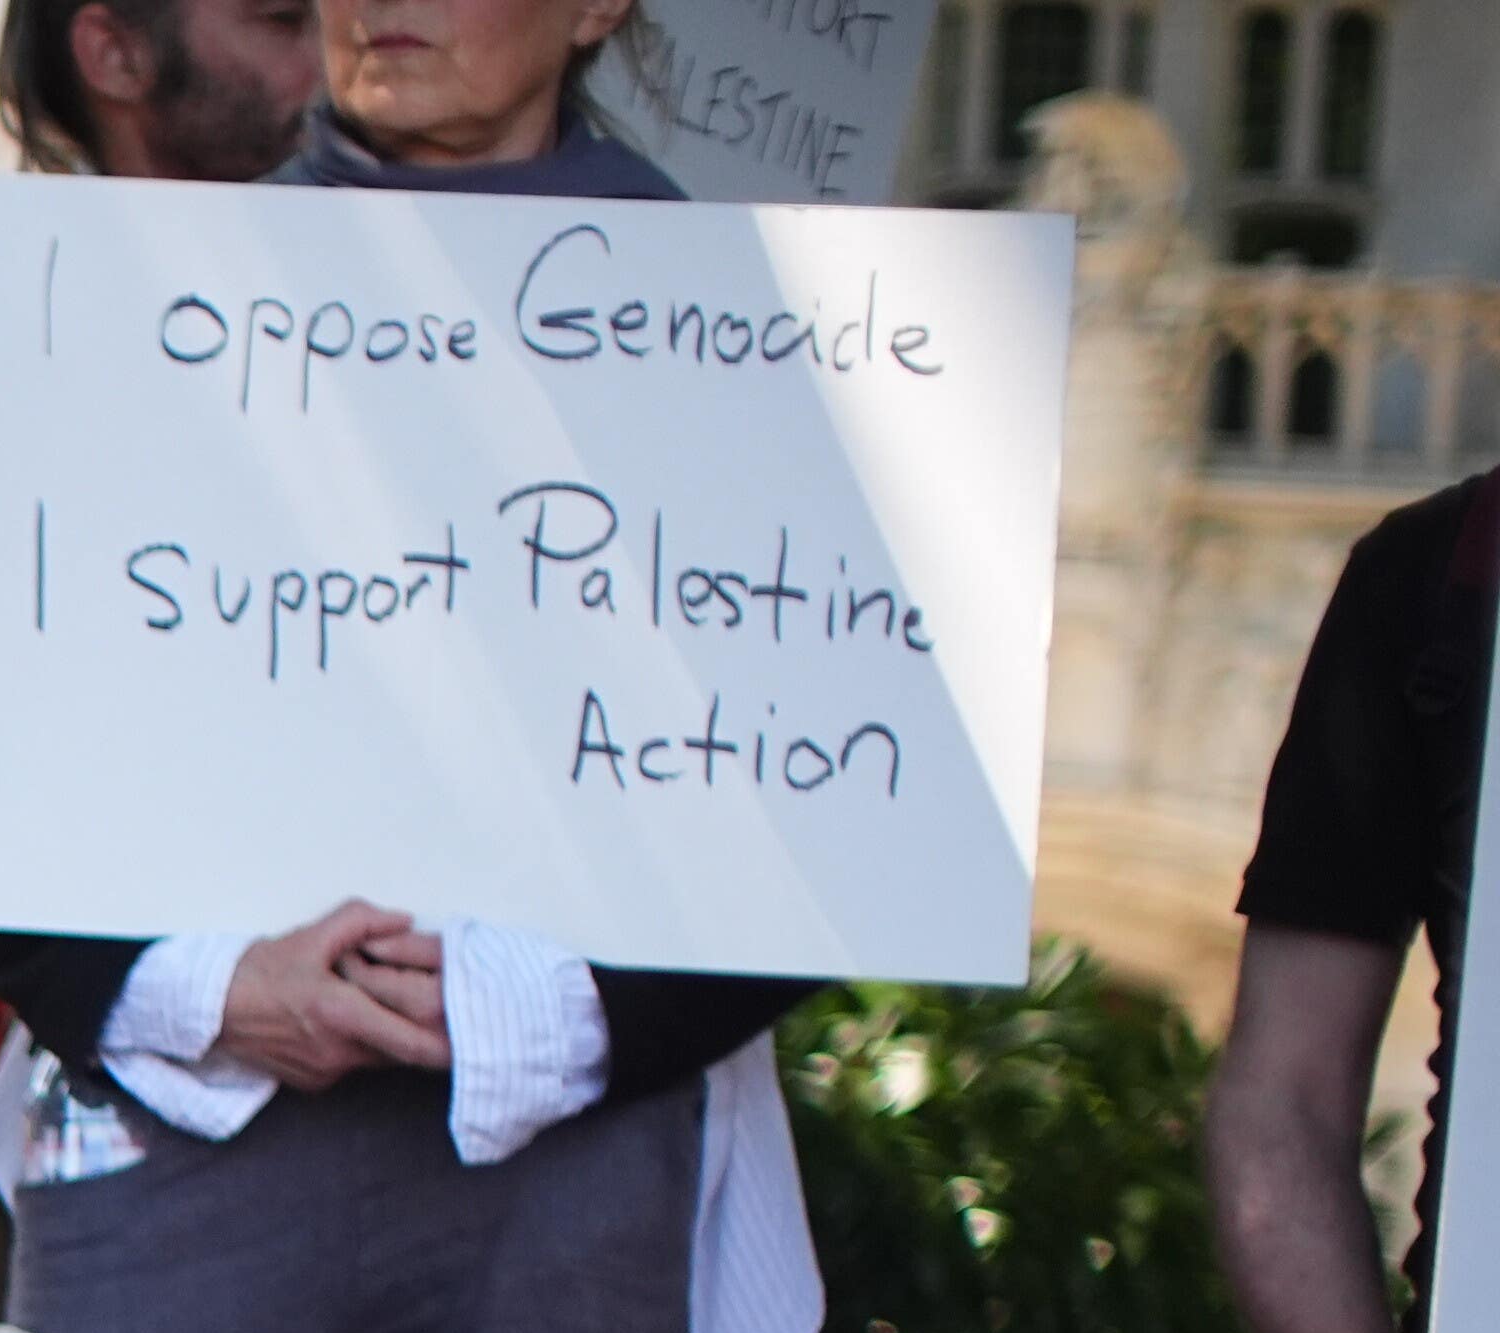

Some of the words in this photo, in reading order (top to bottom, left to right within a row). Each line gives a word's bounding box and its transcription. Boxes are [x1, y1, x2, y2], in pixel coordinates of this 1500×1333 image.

[41, 235, 62, 357] I
[516, 224, 944, 377] Genocide
[500, 481, 934, 653] Palestine
[571, 687, 900, 797] Action
